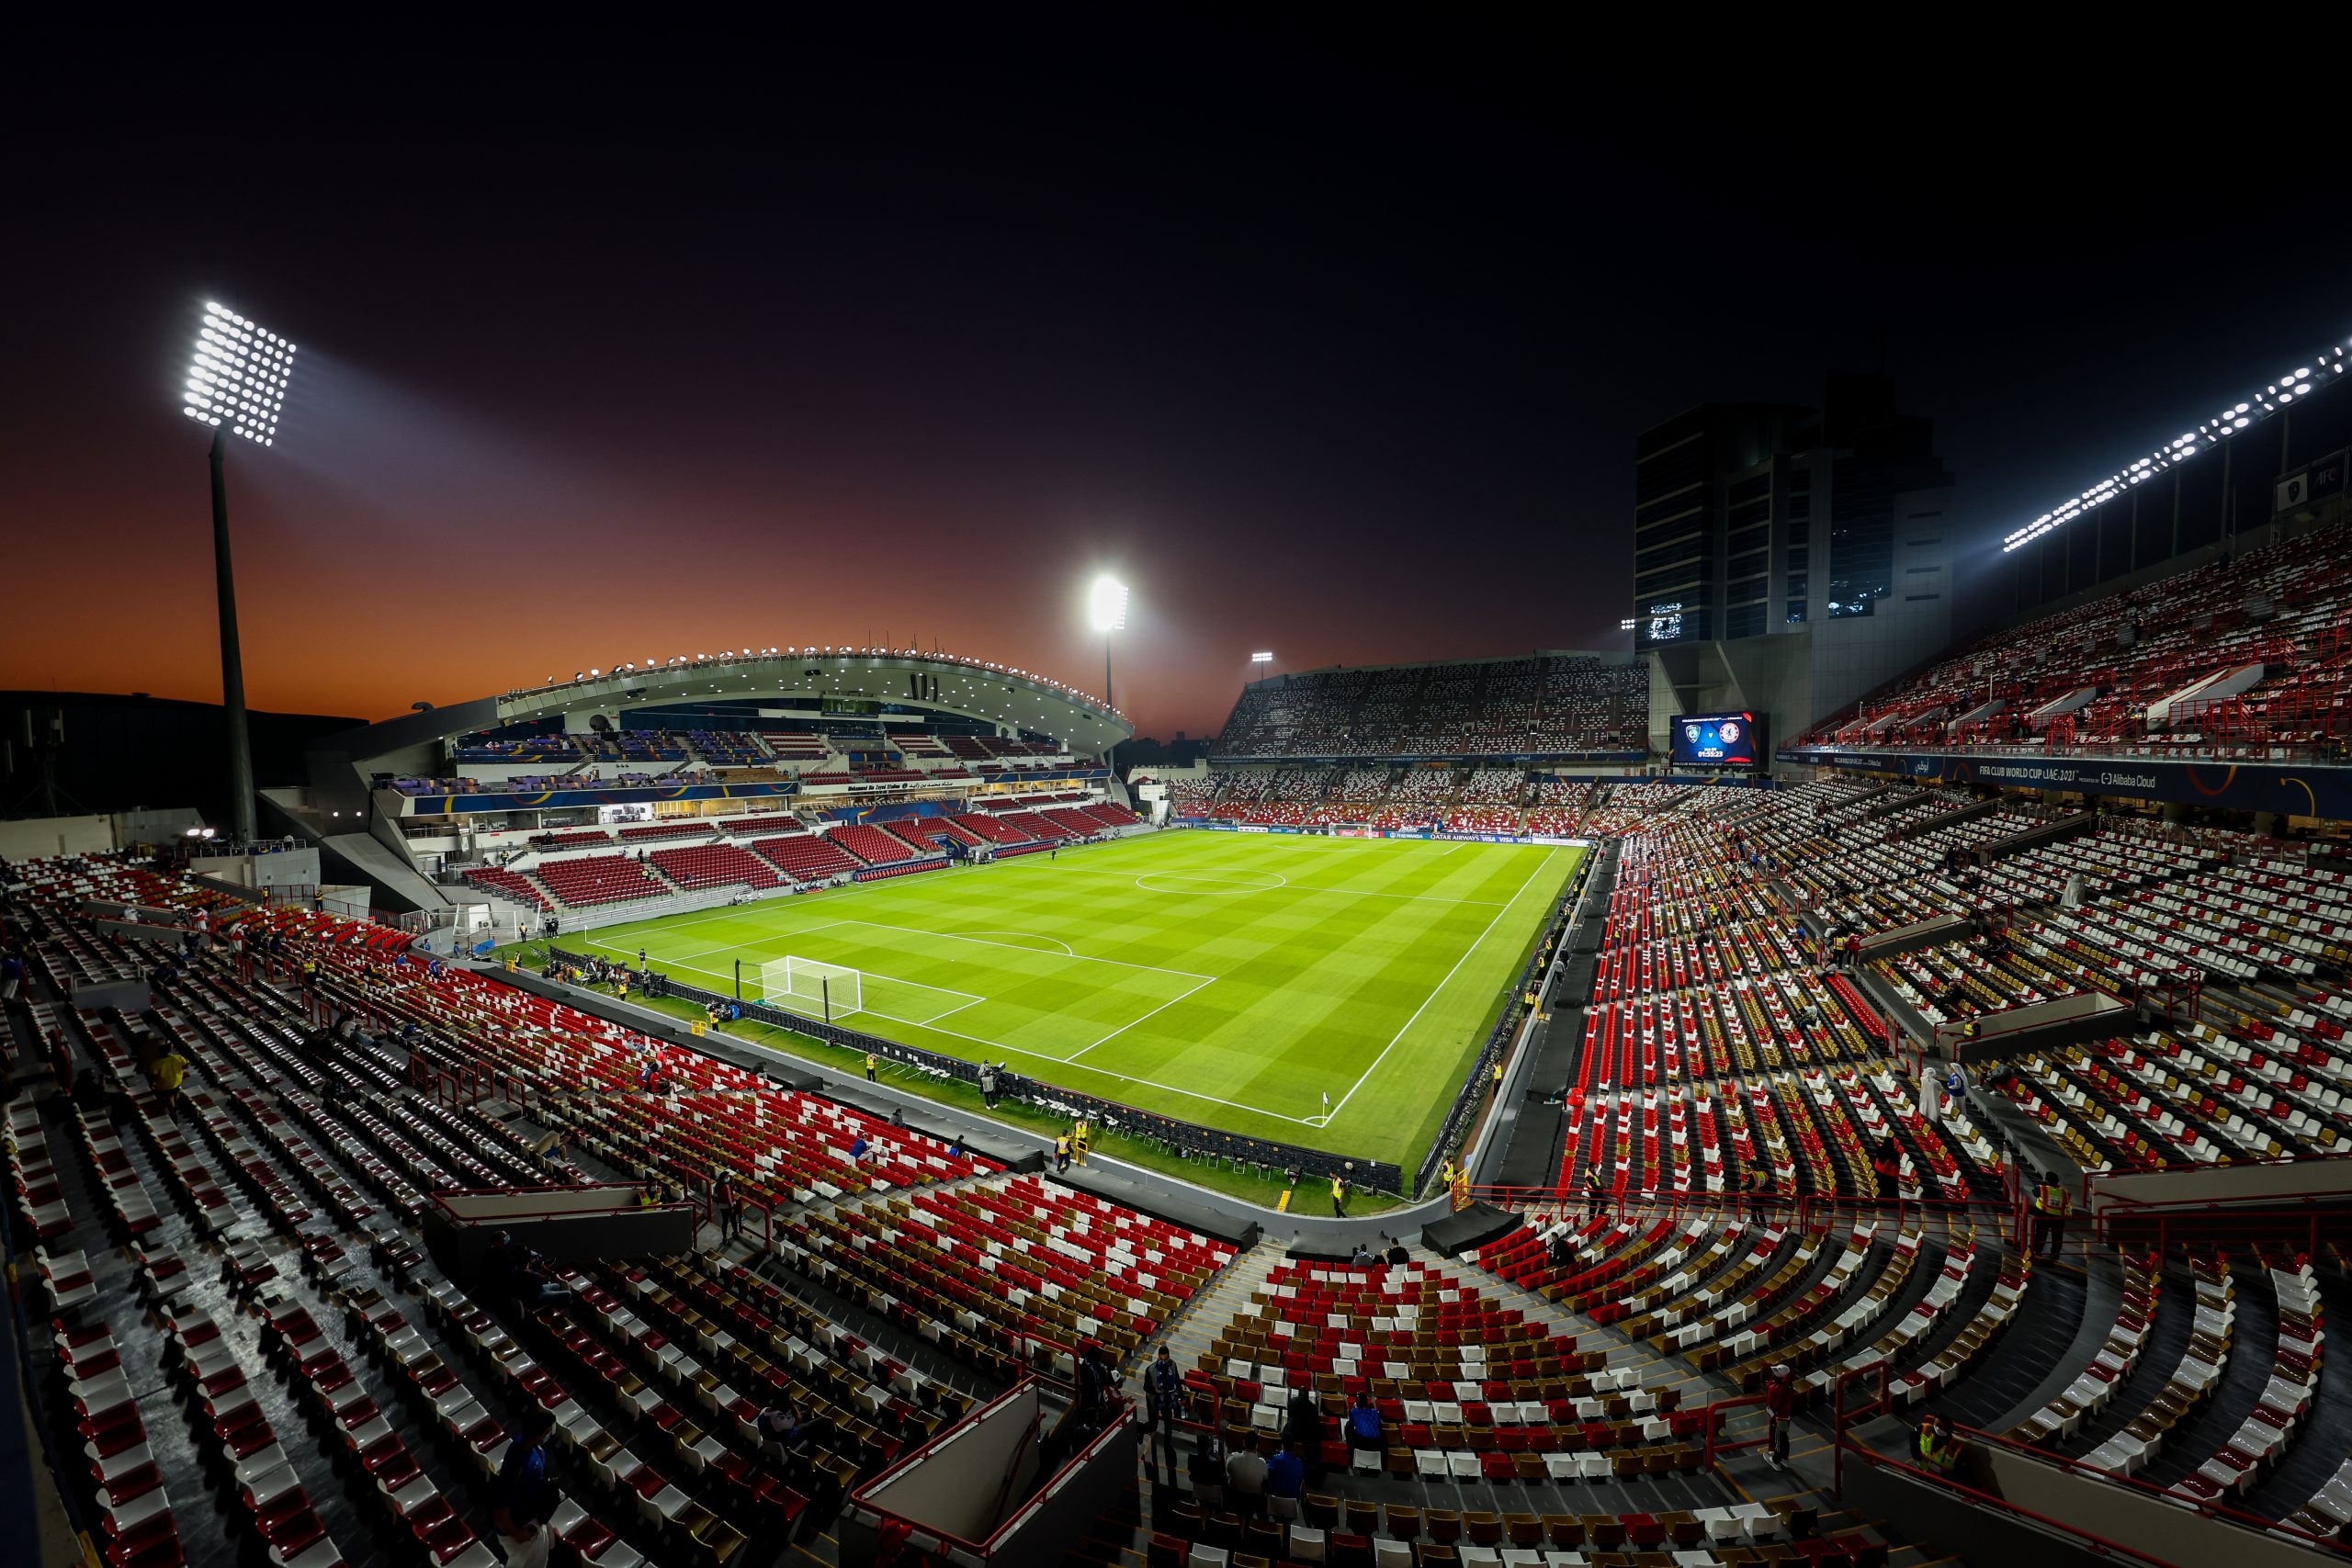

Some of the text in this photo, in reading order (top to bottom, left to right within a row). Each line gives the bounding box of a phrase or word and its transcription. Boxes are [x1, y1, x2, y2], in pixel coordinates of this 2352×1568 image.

[1980, 766, 1991, 776] FIFA
[1991, 766, 2005, 777] CLUB
[2006, 767, 2028, 778] WORLD
[2029, 768, 2042, 779] CUP
[2060, 769, 2075, 782] 2021
[2113, 773, 2136, 786] Alibaba
[2136, 775, 2155, 788] Cloud
